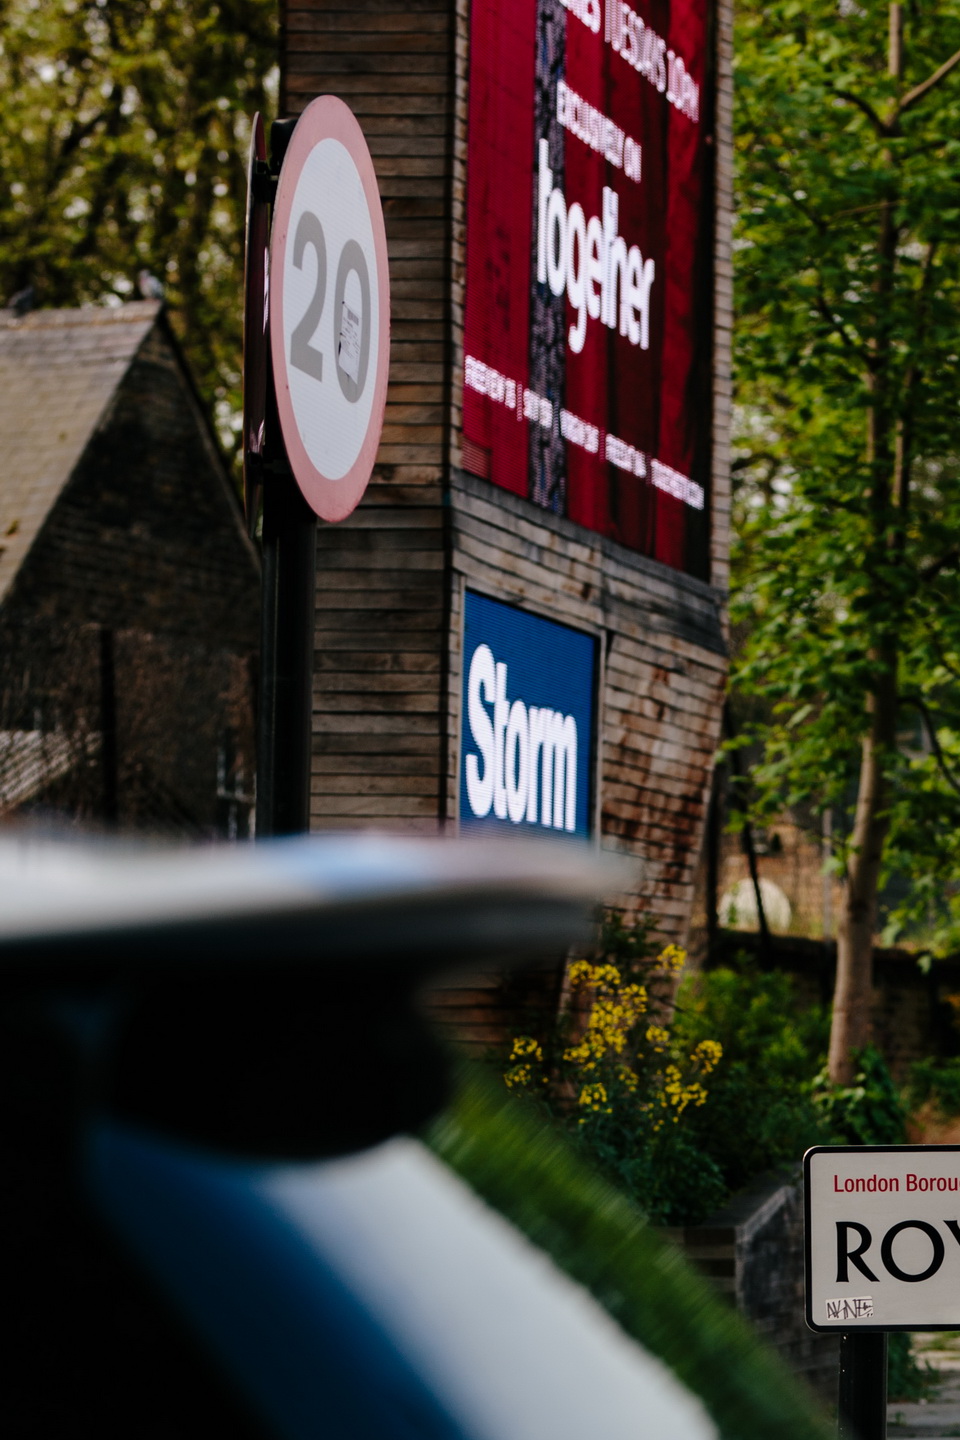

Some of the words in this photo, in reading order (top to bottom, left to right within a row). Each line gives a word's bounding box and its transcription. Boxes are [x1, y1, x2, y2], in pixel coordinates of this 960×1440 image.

[290, 210, 372, 404] 20
[465, 643, 577, 833] Storm
[834, 1174, 900, 1192] London
